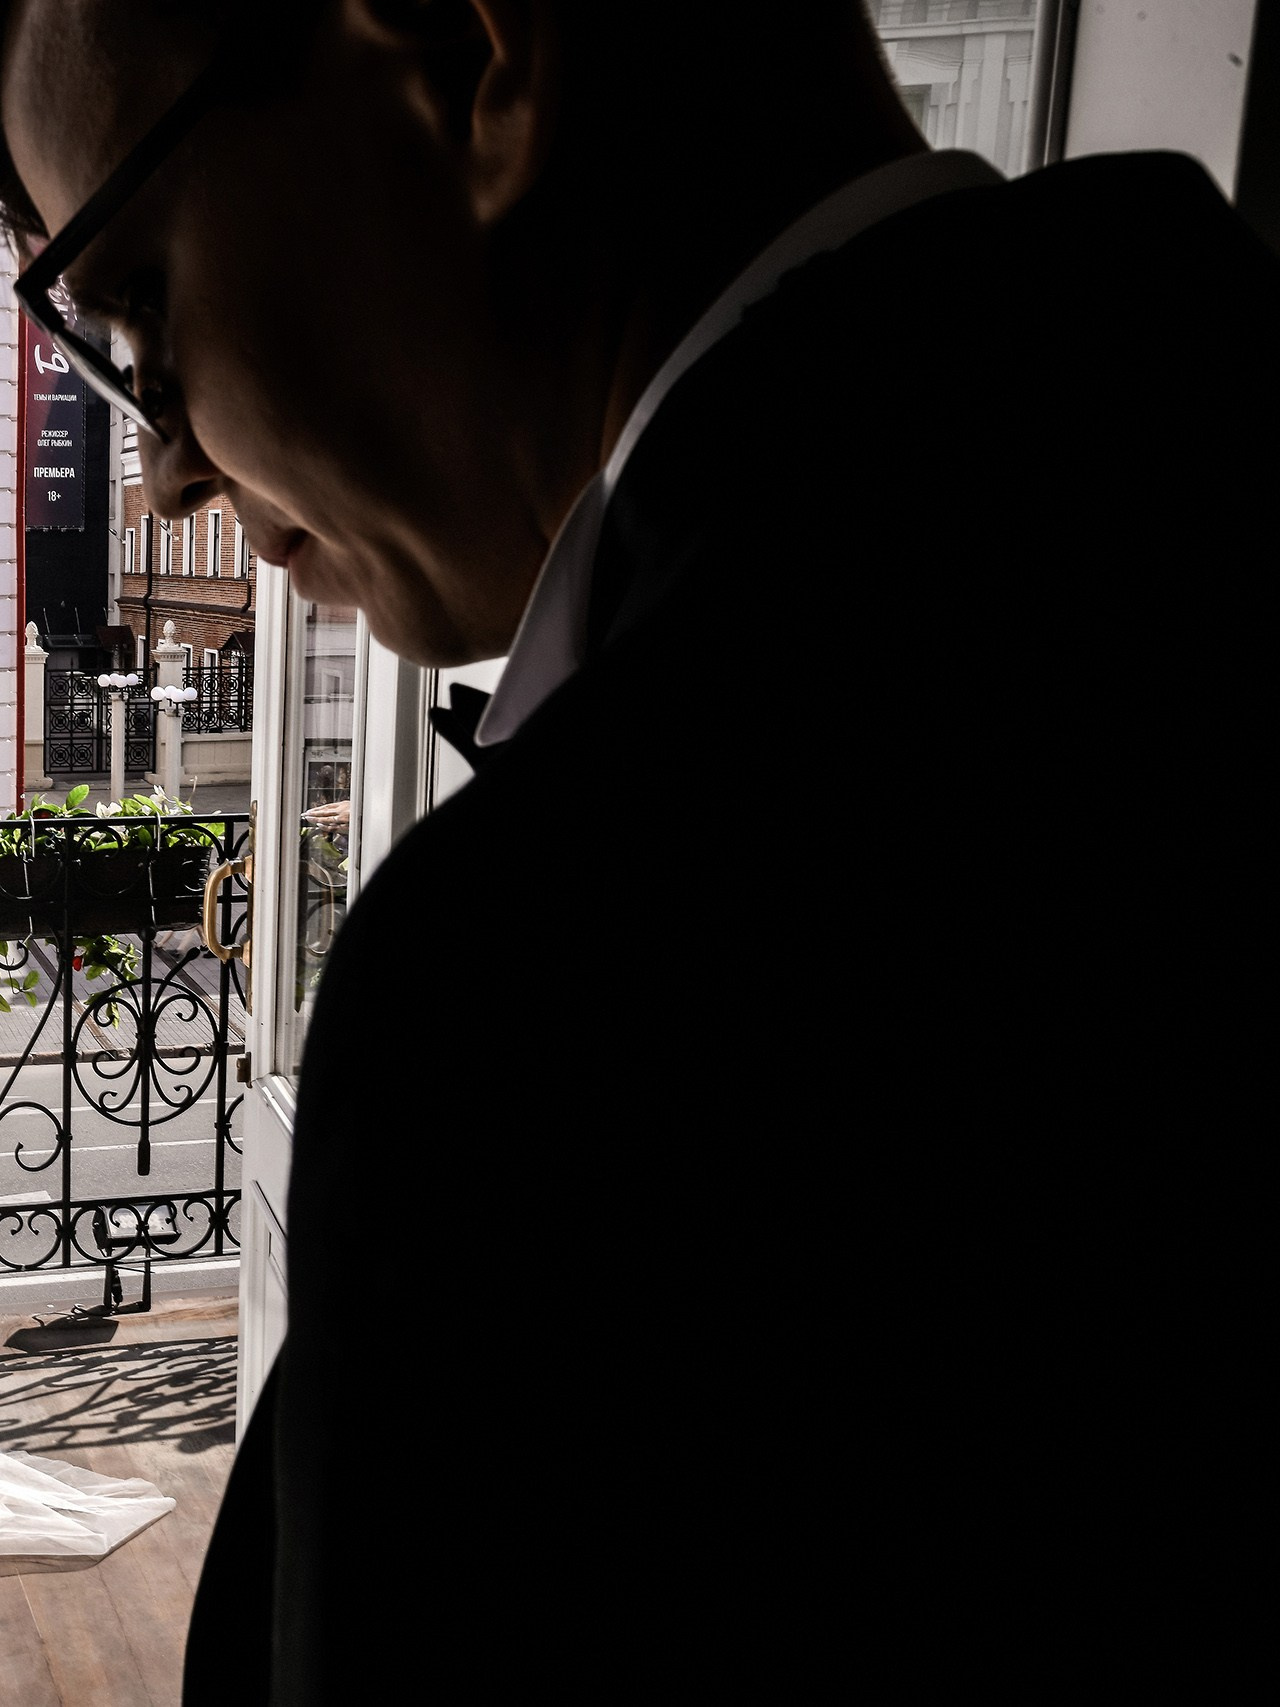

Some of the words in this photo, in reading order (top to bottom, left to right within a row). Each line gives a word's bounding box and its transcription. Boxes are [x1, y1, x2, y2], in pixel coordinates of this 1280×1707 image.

[52, 393, 77, 402] ВАРИАЦИИ
[41, 430, 68, 438] РЕЖИССЕР
[37, 439, 51, 447] ОЛЕГ
[51, 439, 73, 447] РЫБКИН
[33, 467, 76, 478] ПРЕМЬЕРА
[47, 490, 62, 502] 18+
